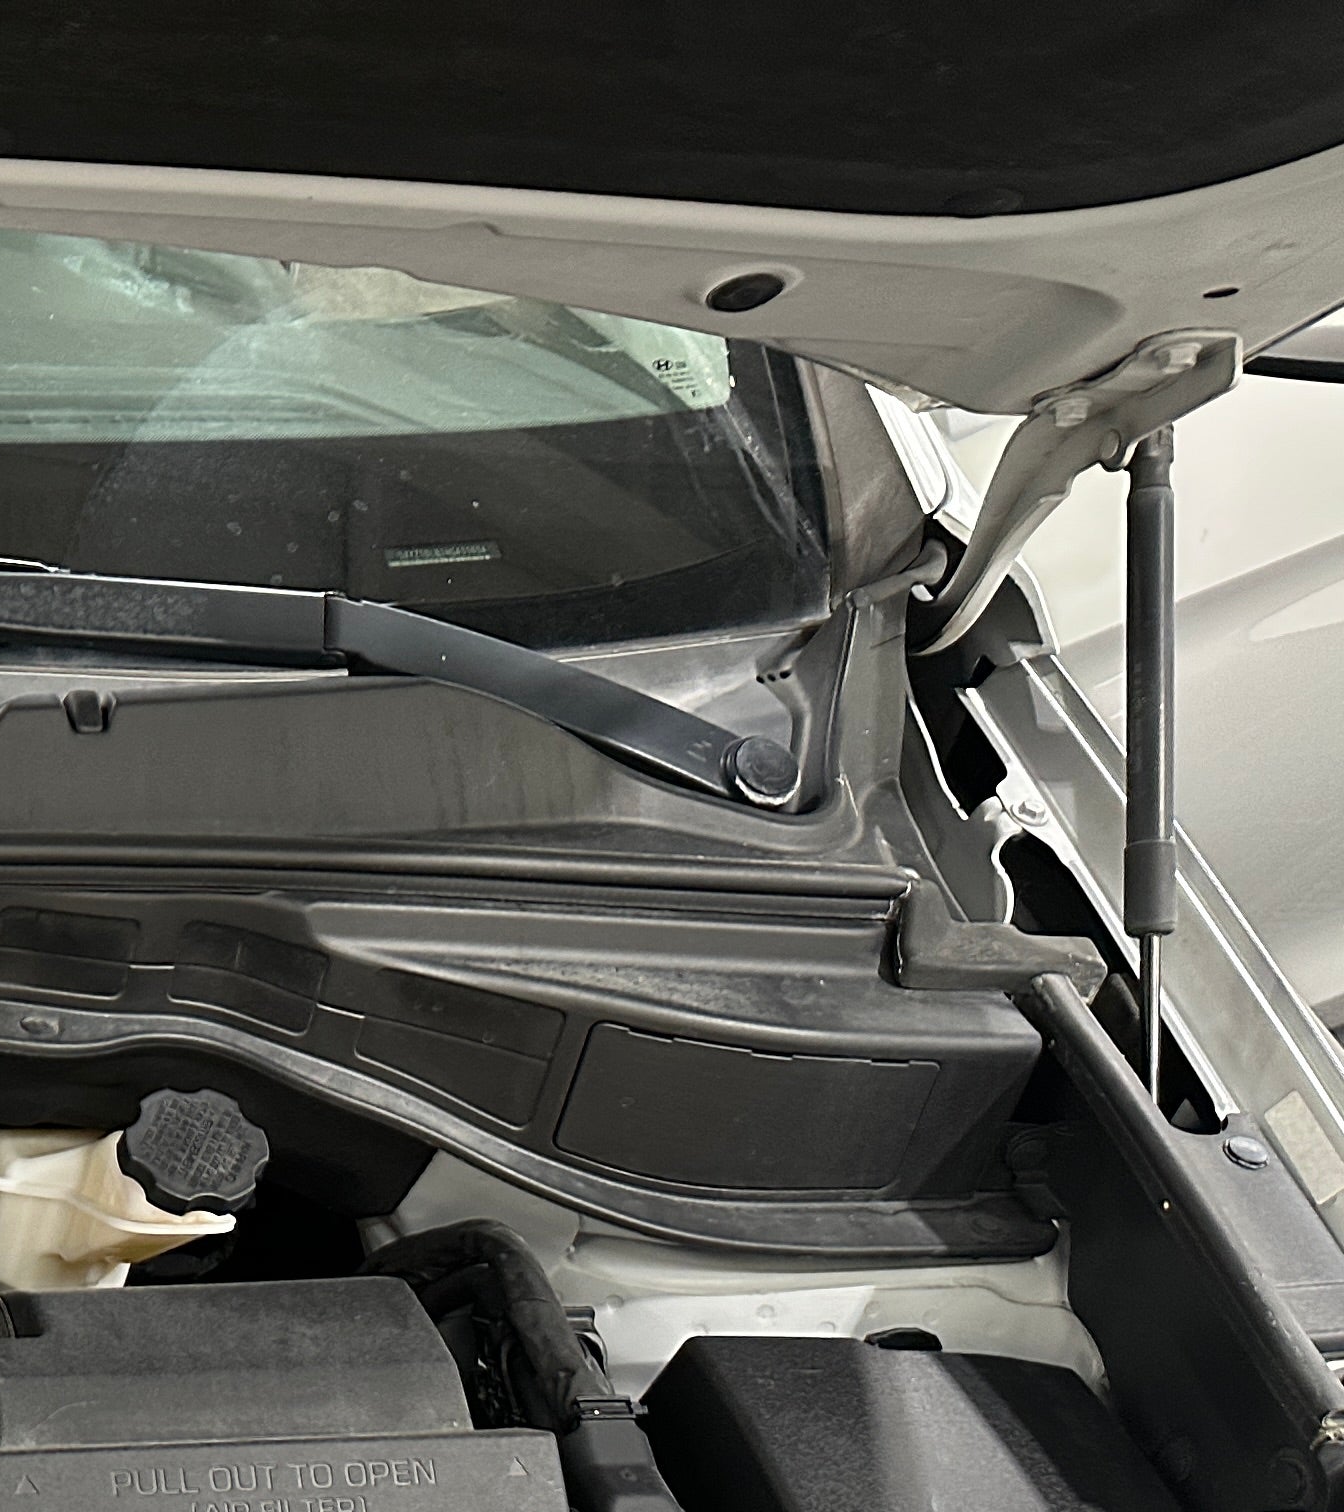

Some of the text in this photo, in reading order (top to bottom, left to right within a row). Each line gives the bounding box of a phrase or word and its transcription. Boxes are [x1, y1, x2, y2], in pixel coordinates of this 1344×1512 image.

[112, 1457, 438, 1498] PULL OUT TO OPEN
